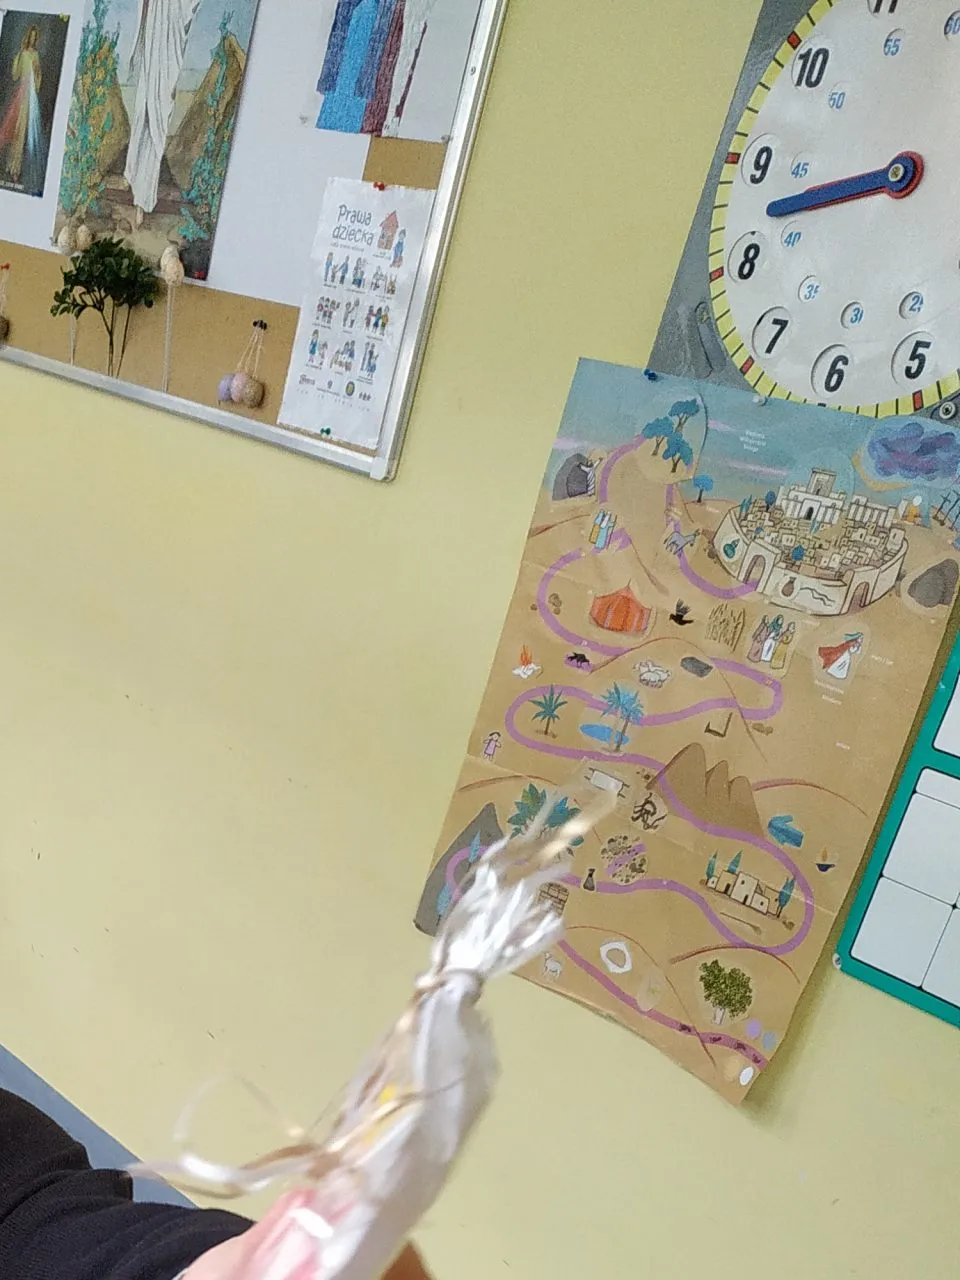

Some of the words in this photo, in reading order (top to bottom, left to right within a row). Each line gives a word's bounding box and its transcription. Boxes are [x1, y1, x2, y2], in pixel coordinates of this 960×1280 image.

[884, 38, 901, 56] 55
[796, 47, 830, 89] 10
[828, 92, 846, 109] 50
[750, 146, 773, 184] 9
[791, 162, 809, 179] 45
[337, 204, 372, 226] Prawa
[332, 224, 374, 246] dziecka
[738, 243, 761, 280] 8
[765, 318, 789, 354] 7
[824, 355, 849, 392] 6
[904, 340, 932, 380] 5
